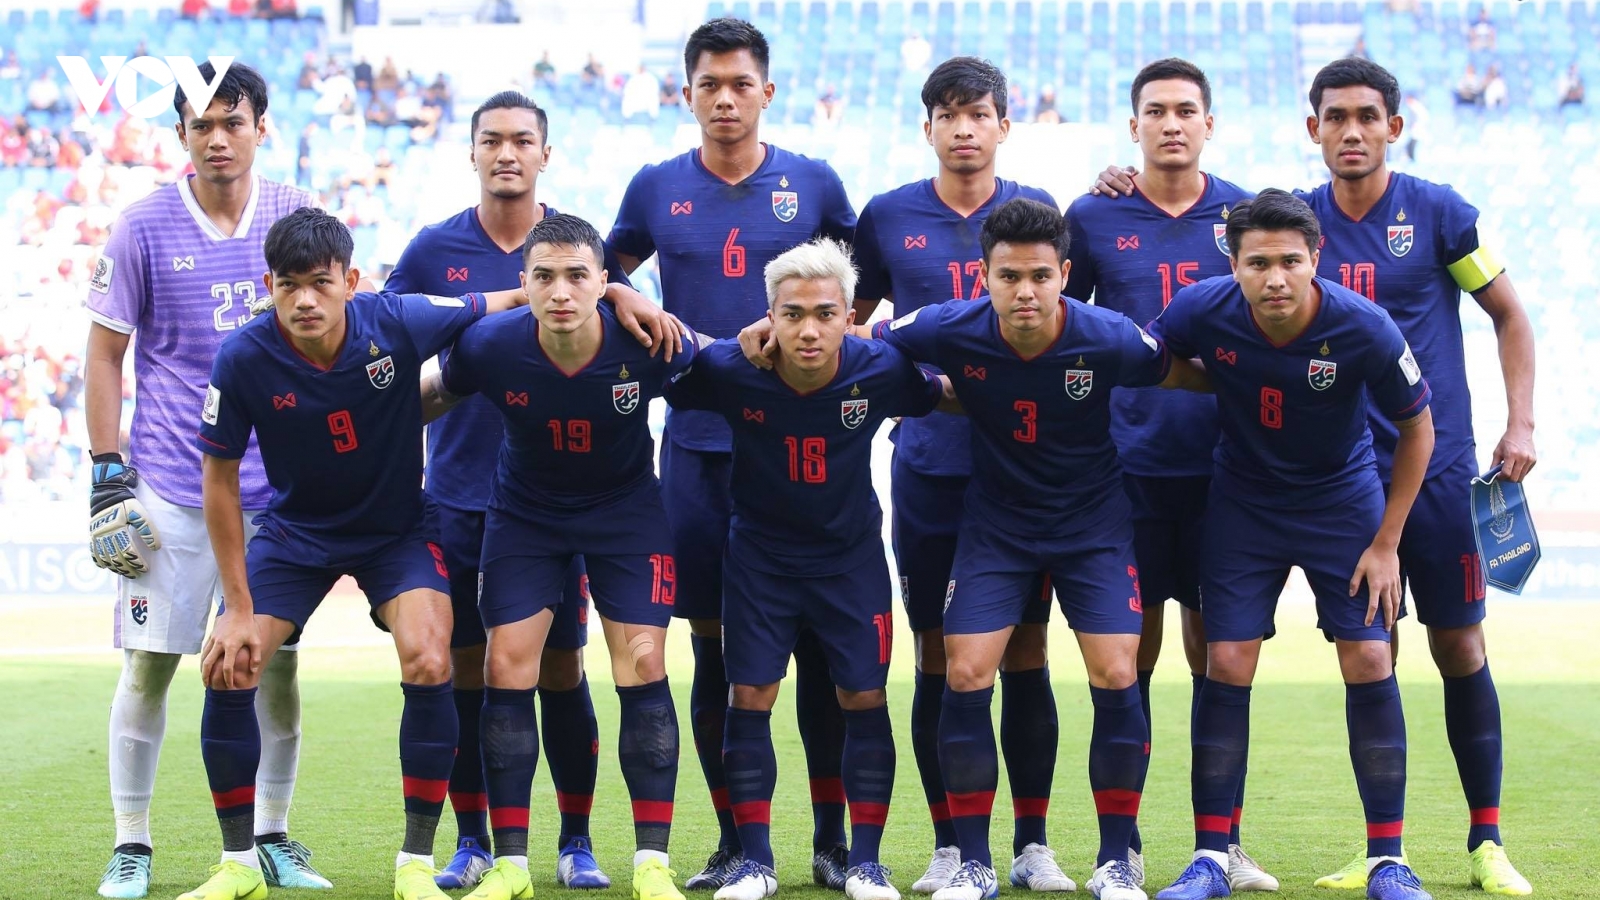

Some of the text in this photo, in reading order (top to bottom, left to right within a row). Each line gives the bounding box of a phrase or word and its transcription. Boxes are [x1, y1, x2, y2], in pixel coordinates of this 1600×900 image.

[723, 228, 746, 277] 6
[1339, 263, 1375, 303] 10
[211, 281, 257, 332] 23
[1013, 400, 1038, 443] 3
[1260, 386, 1283, 429] 8
[326, 409, 358, 453] 9
[547, 420, 592, 453] 19
[784, 436, 826, 483] 18
[1499, 542, 1532, 565] THAILAND
[649, 553, 677, 606] 19
